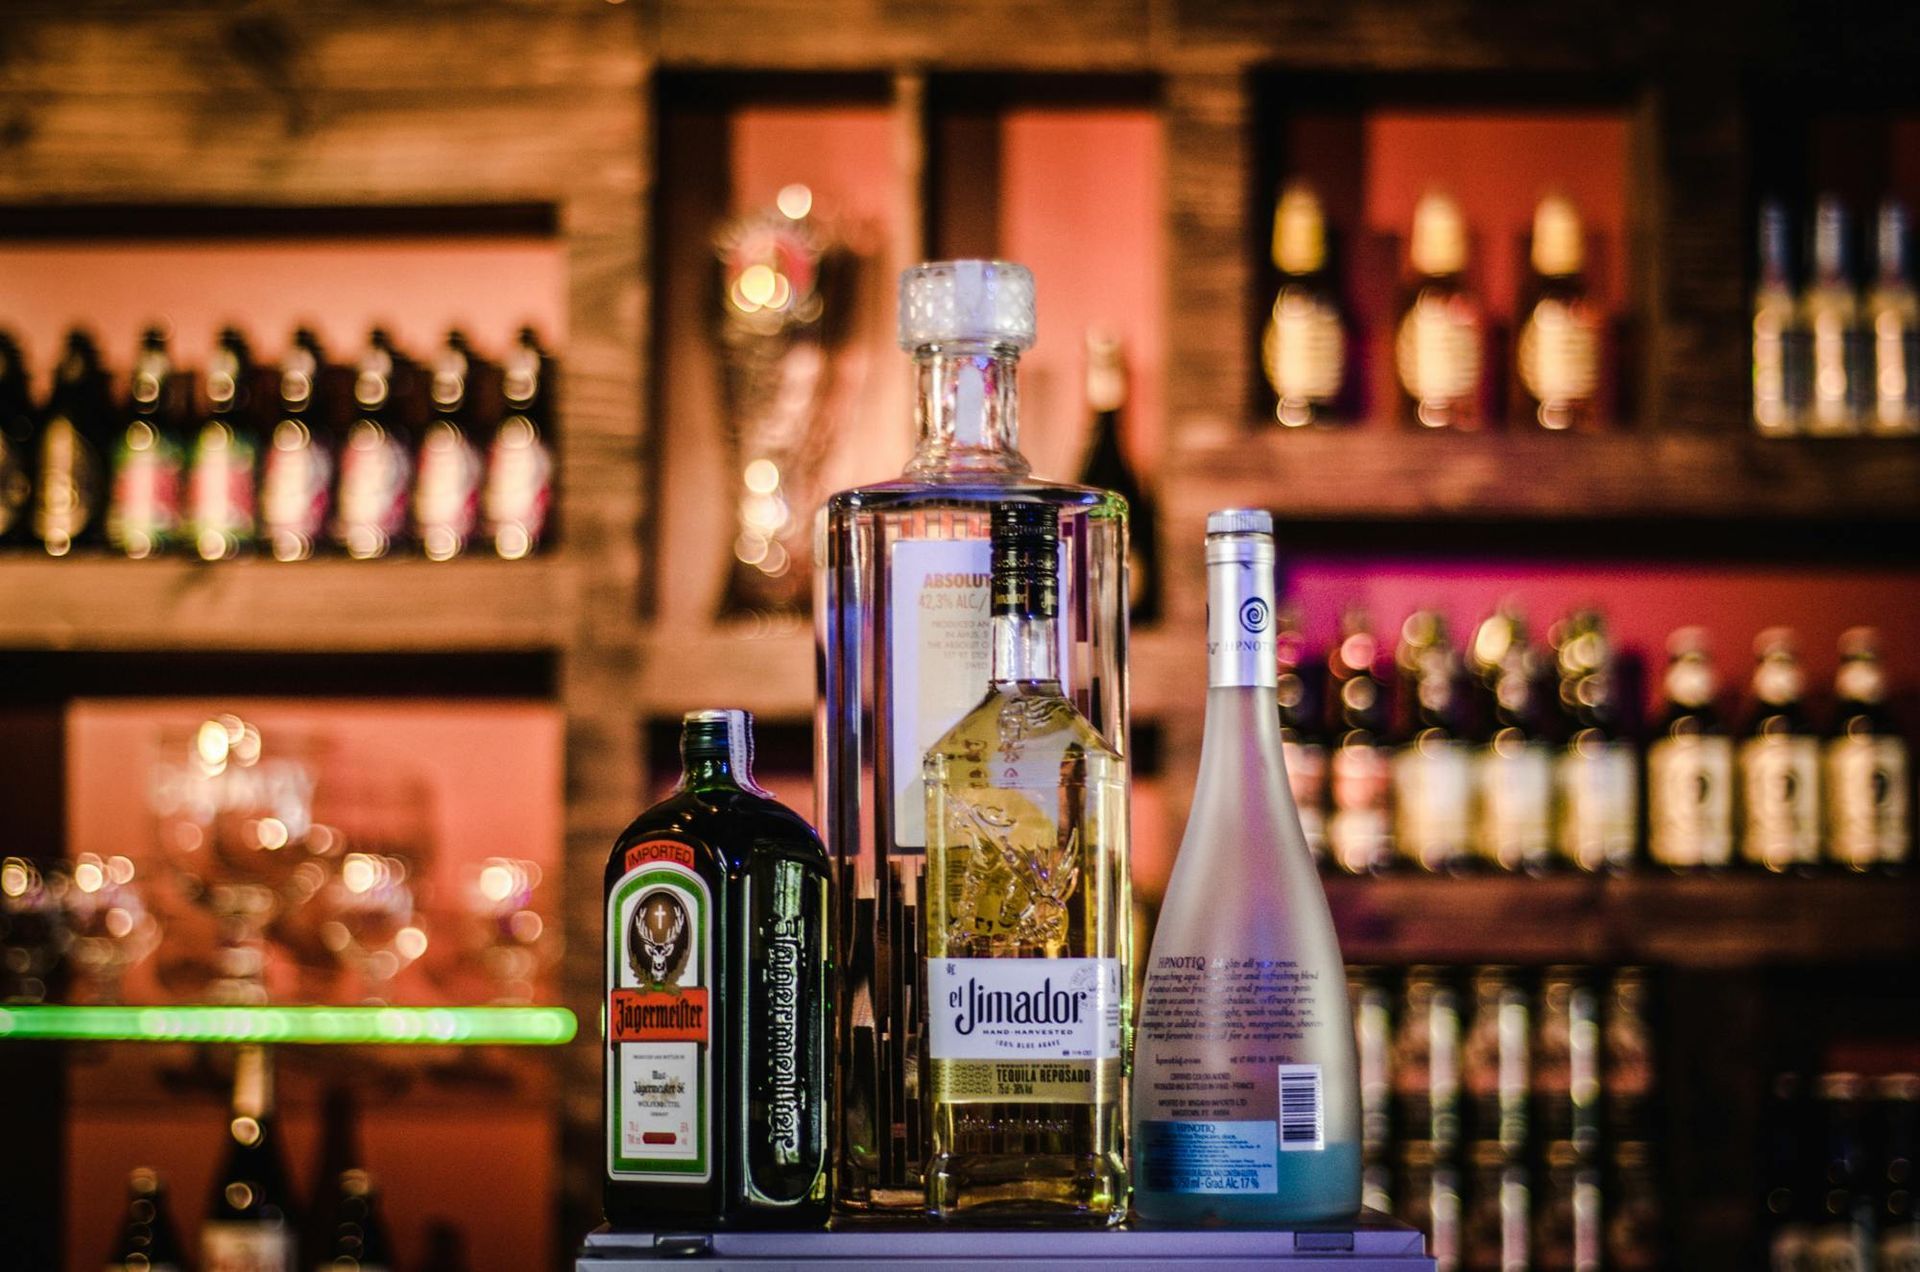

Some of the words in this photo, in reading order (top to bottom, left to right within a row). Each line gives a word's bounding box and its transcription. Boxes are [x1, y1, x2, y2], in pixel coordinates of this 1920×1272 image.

[924, 574, 990, 588] ABSOLUT
[628, 845, 692, 867] IMPORTED
[1158, 957, 1206, 970] HPNOTIQ
[949, 986, 962, 1008] el
[955, 977, 1087, 1036] Jimador
[1016, 1041, 1035, 1049] BLUE
[1038, 1039, 1061, 1048] AGAVE
[997, 1069, 1037, 1083] TEQUILA
[1040, 1069, 1091, 1083] REPOSADO
